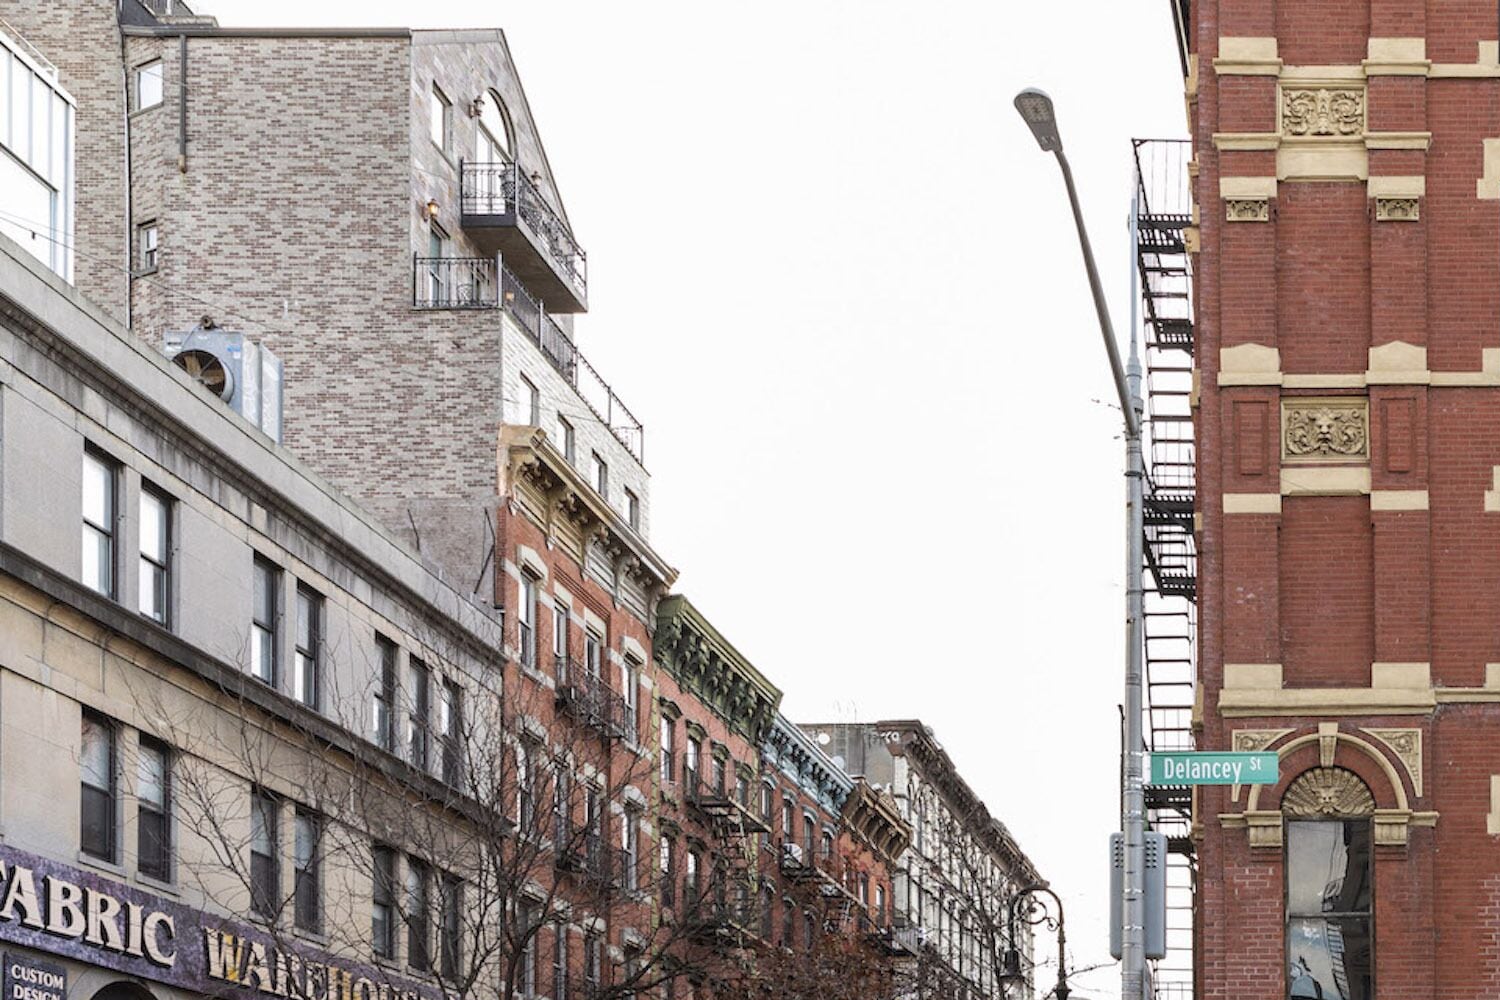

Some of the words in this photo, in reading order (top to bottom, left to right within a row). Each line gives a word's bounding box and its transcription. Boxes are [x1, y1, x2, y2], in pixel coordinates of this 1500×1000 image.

[1164, 758, 1242, 784] Delancey
[1250, 757, 1262, 771] St
[0, 860, 176, 967] ABRIC
[11, 964, 64, 990] CUSTOM
